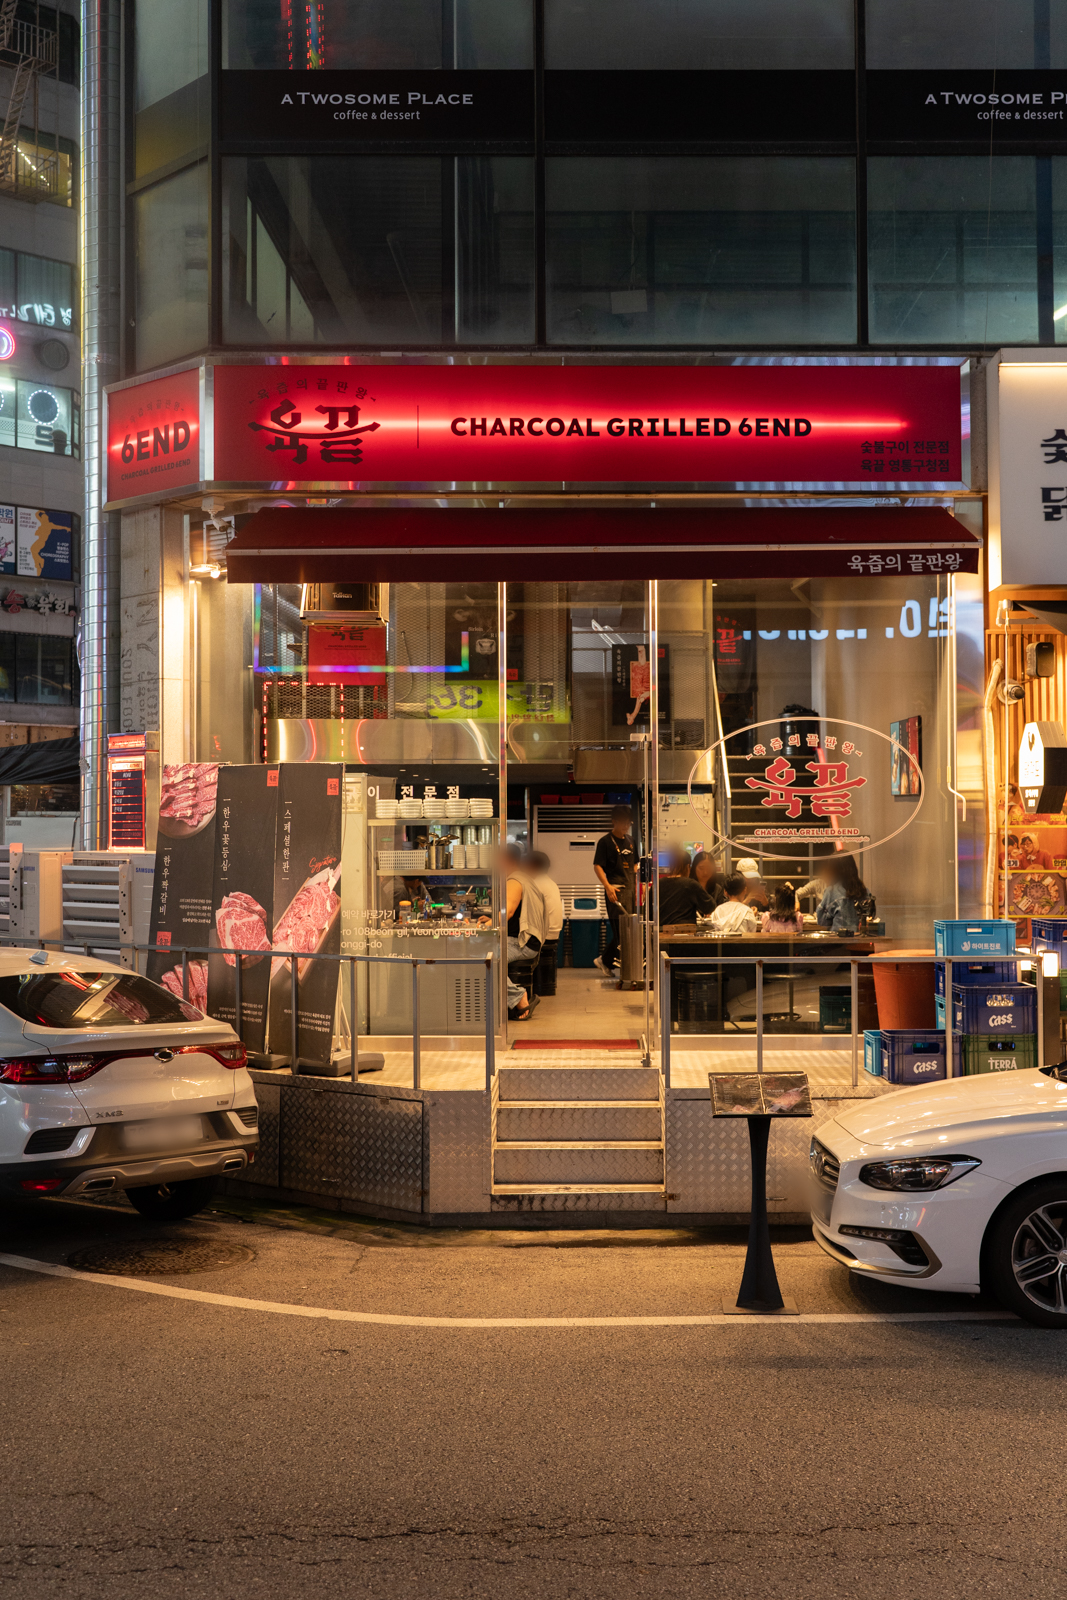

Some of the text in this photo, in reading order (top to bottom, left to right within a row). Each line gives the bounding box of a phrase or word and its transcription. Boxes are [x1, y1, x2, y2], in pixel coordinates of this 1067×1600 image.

[296, 92, 400, 104] TWOSOME
[407, 92, 473, 104] PLACE
[940, 92, 1043, 104] TWOSOME
[333, 109, 420, 120] coffee & dessert
[977, 109, 1063, 120] coffee & dessert
[450, 416, 812, 437] CHARCOAL GRILLED 6END
[121, 420, 190, 464] 6END
[860, 440, 949, 454] 숯불구이 전문점
[121, 458, 191, 481] CHARCOAL GRILLED 6END
[860, 459, 949, 472] 육끝 영통구청점
[847, 552, 963, 573] 육즙의 끝판왕
[122, 696, 133, 729] FOO
[745, 756, 868, 818] 육끝
[754, 828, 859, 836] CHARCOAL GRILLED 6END
[341, 909, 396, 920] 예약 바로가기
[412, 927, 479, 938] Yeongtong-gu,
[340, 940, 382, 950] onggi-do
[988, 1057, 1017, 1070] TERRA
[96, 1110, 124, 1119] XM3
